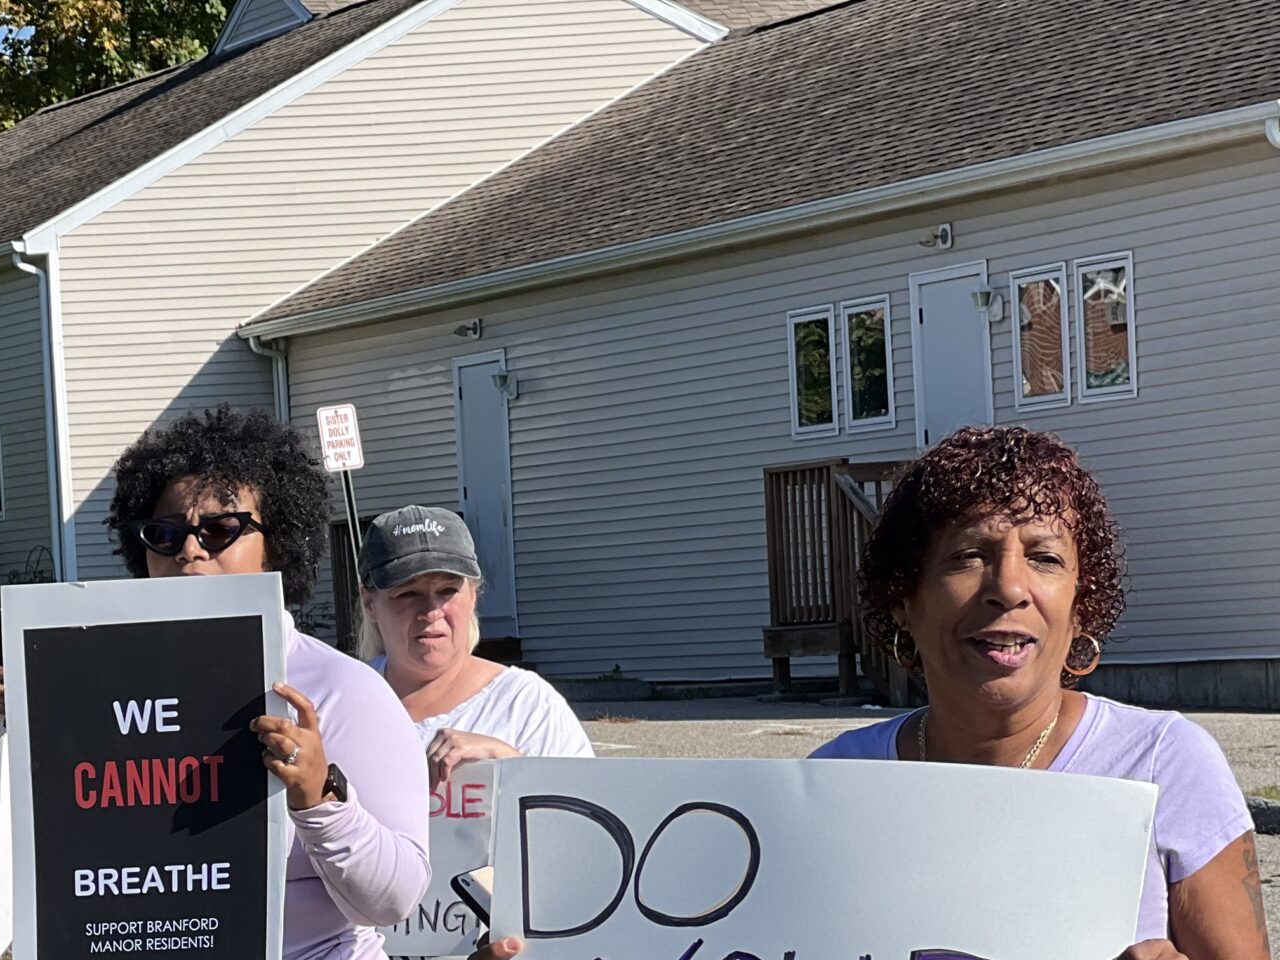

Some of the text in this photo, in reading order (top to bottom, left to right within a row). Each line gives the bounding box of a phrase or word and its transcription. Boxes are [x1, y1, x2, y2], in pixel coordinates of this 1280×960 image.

[325, 414, 349, 425] SISTER
[328, 426, 349, 437] DOLLY
[326, 437, 355, 450] PARKING
[334, 450, 351, 462] ONLY
[113, 698, 180, 735] WE
[74, 755, 224, 809] CANNOT
[518, 795, 761, 938] DO
[74, 863, 231, 897] BREATHE
[85, 917, 219, 936] SUPPORT BRANFORD
[90, 935, 214, 953] MANOR RESIDENTS!
